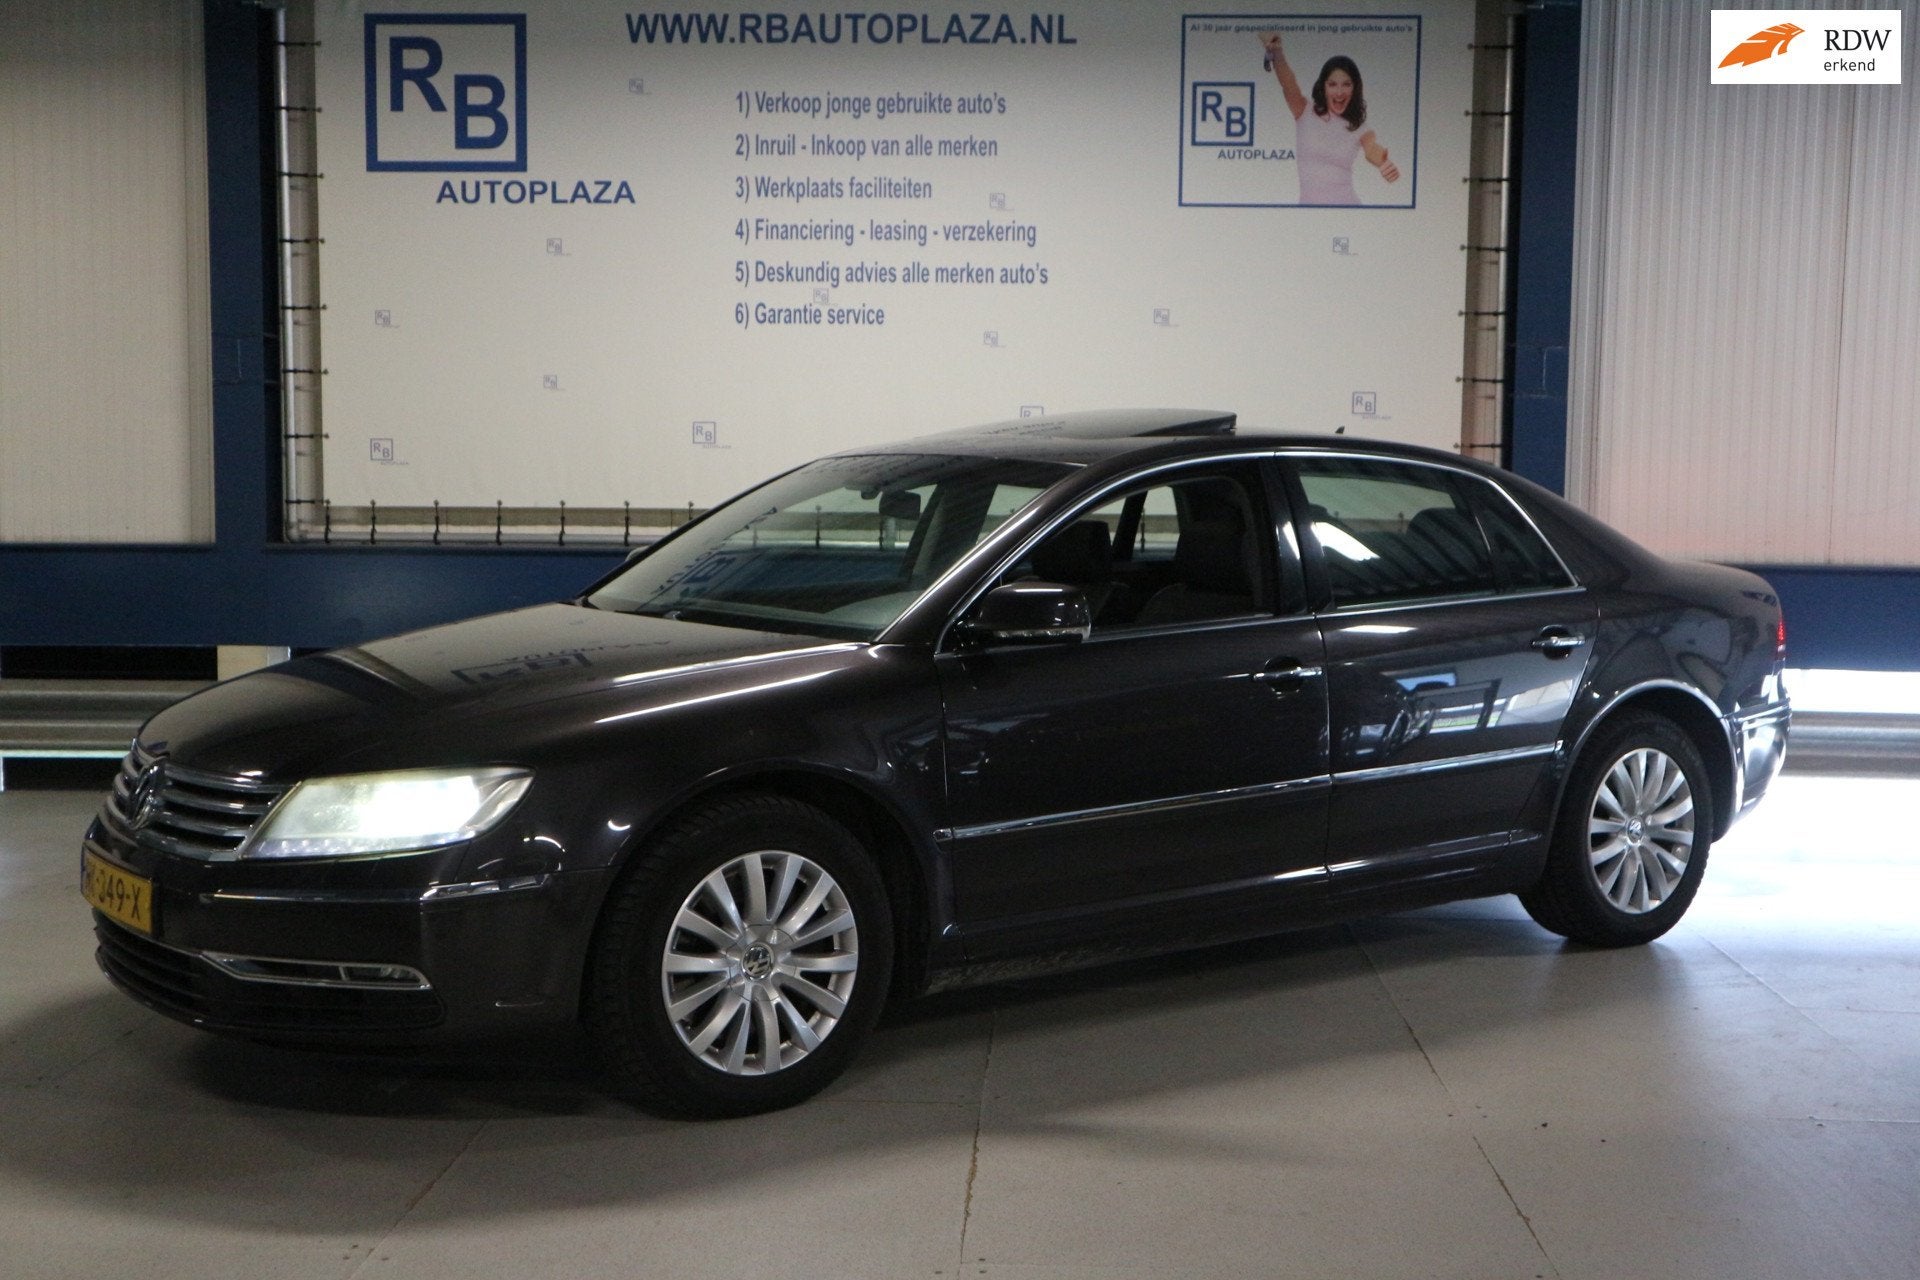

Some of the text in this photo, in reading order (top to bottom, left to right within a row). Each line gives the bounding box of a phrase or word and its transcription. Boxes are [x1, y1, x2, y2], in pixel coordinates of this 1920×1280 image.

[626, 13, 1077, 44] WWW.RBAUTOPLAZA.NL
[1307, 24, 1316, 32] in
[1318, 24, 1338, 33] jong
[1341, 24, 1383, 33] gebruikte
[388, 36, 508, 149] RB
[736, 91, 1006, 119] 1) Verkoop jonge gebruikte auto's
[1201, 91, 1247, 137] RB
[736, 134, 750, 160] 2)
[756, 134, 795, 155] Inruil
[812, 134, 866, 161] Inkoop
[871, 140, 899, 155] van
[905, 134, 933, 156] alle
[939, 135, 997, 156] merken
[1218, 149, 1295, 160] AUTOPLAZA
[436, 181, 635, 204] AUTOPLAZA
[736, 176, 932, 203] 3) Werkplaats faciliteiten
[735, 219, 749, 244] 4)
[755, 218, 854, 246] Financiering
[870, 219, 927, 246] leasing
[943, 220, 1036, 248] verzekering
[736, 261, 1048, 288] 5) Deskundig advies alle merken auto's
[735, 302, 884, 329] 6) Garantie service
